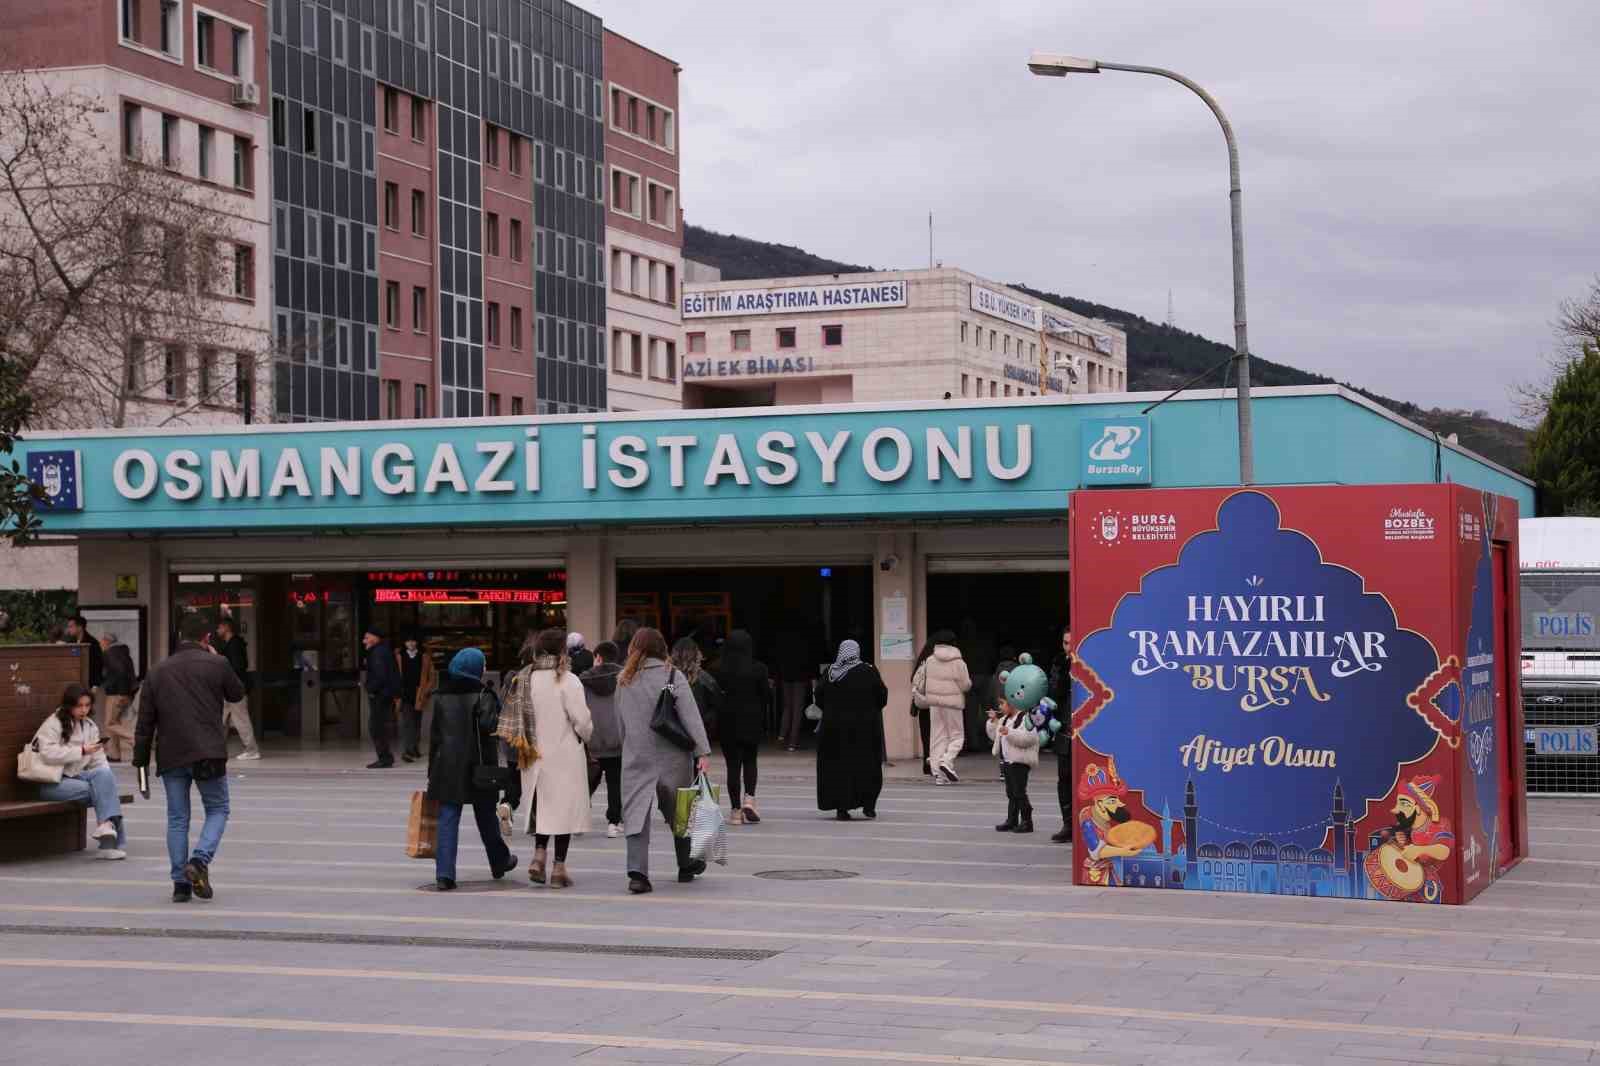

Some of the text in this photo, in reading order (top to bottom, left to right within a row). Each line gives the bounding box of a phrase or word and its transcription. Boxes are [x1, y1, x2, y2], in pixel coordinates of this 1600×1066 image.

[684, 282, 905, 313] EĞİTİM ARAŞTIRMA HASTANESİ
[718, 359, 742, 376] EK
[747, 355, 814, 375] BİNASI
[112, 423, 1033, 500] OSMANGAZİ İSTASYONU
[1087, 463, 1144, 476] BursaRay
[1131, 514, 1177, 524] BURSA
[1384, 518, 1434, 528] BOZBEY
[1187, 595, 1326, 623] HAYIRLI
[1539, 612, 1593, 636] POLİS
[1128, 629, 1389, 677] RAMAZANLAR
[1183, 664, 1332, 712] BURSA
[1179, 734, 1337, 772] Afiyet Olsun
[1540, 728, 1593, 753] POLİS
